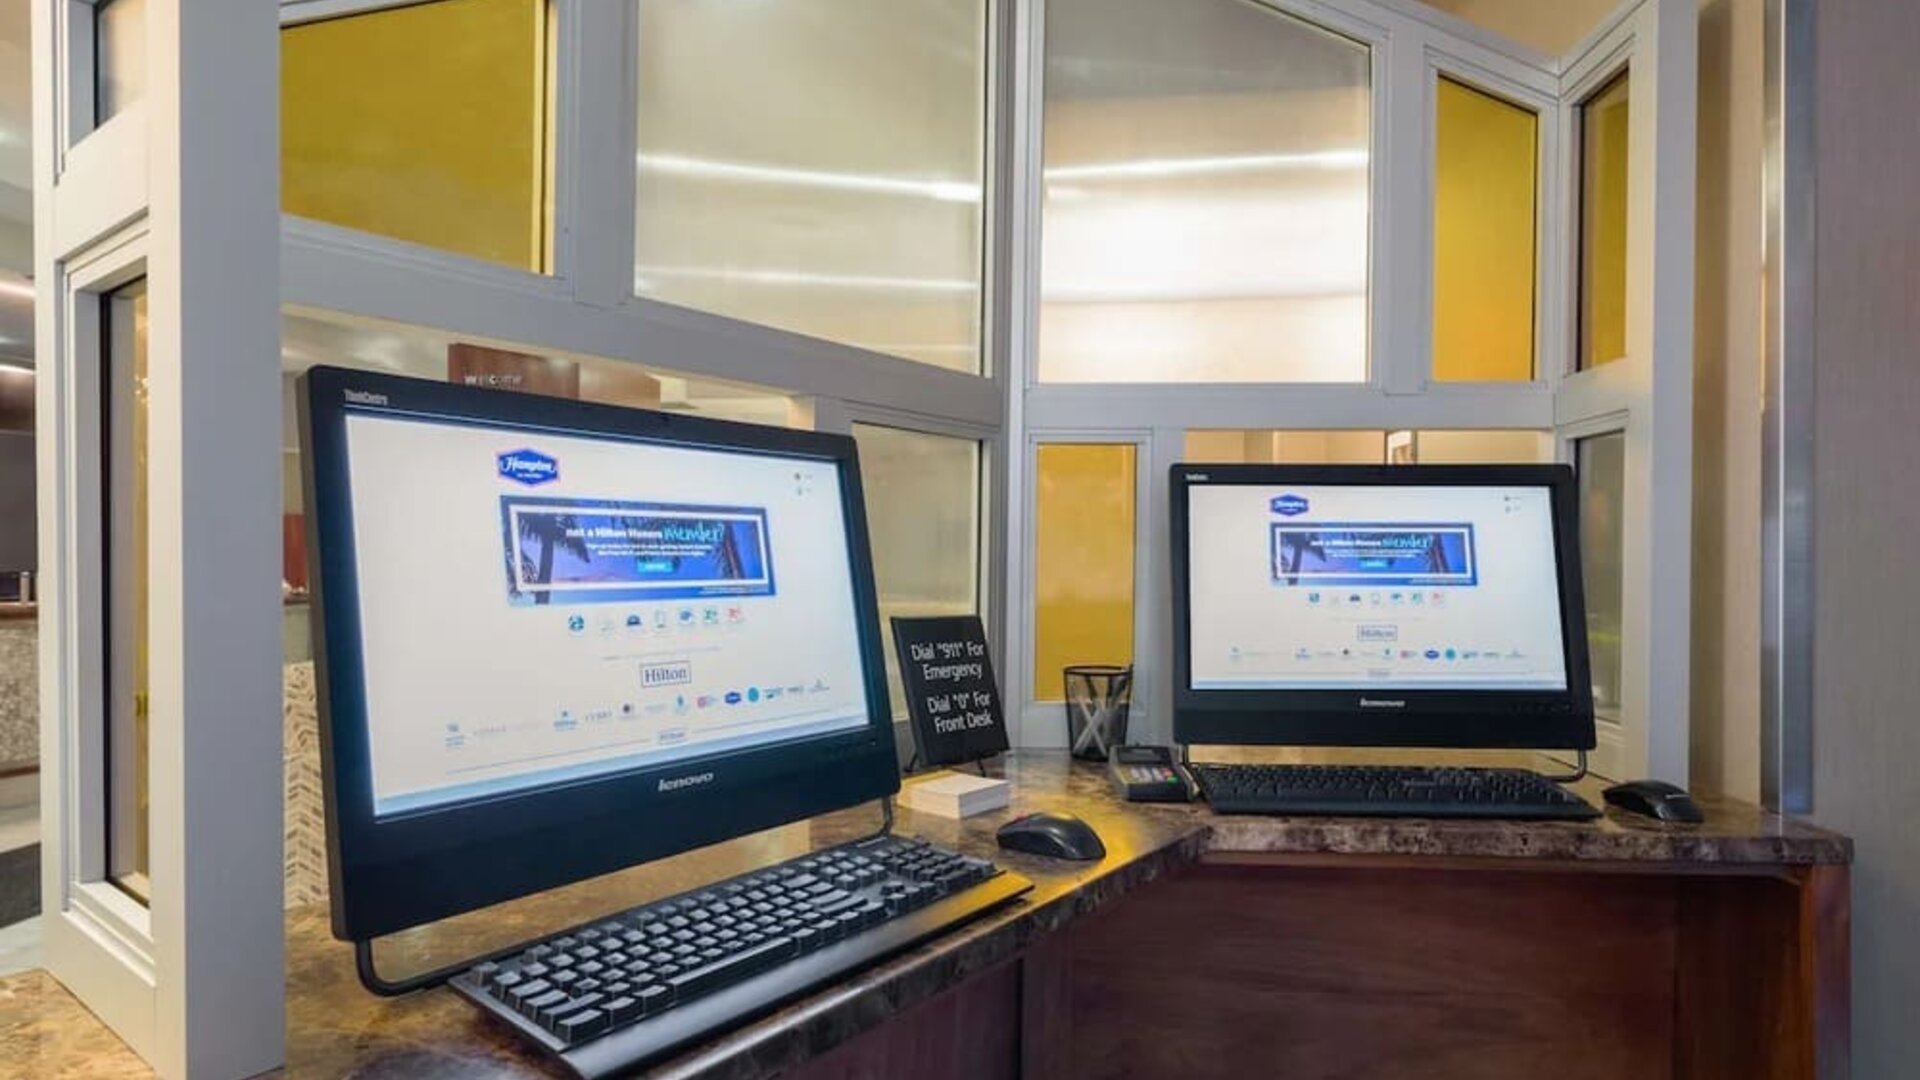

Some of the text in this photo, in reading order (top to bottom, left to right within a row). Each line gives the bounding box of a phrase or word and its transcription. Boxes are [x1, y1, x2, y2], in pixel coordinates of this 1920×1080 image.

[499, 456, 556, 473] Hampton
[911, 641, 984, 661] Dial "911" For
[644, 667, 688, 683] Hilton
[922, 663, 982, 682] Emergency
[926, 691, 990, 714] Dial "0" For
[934, 709, 994, 734] Front Desk
[657, 772, 714, 792] lenovo
